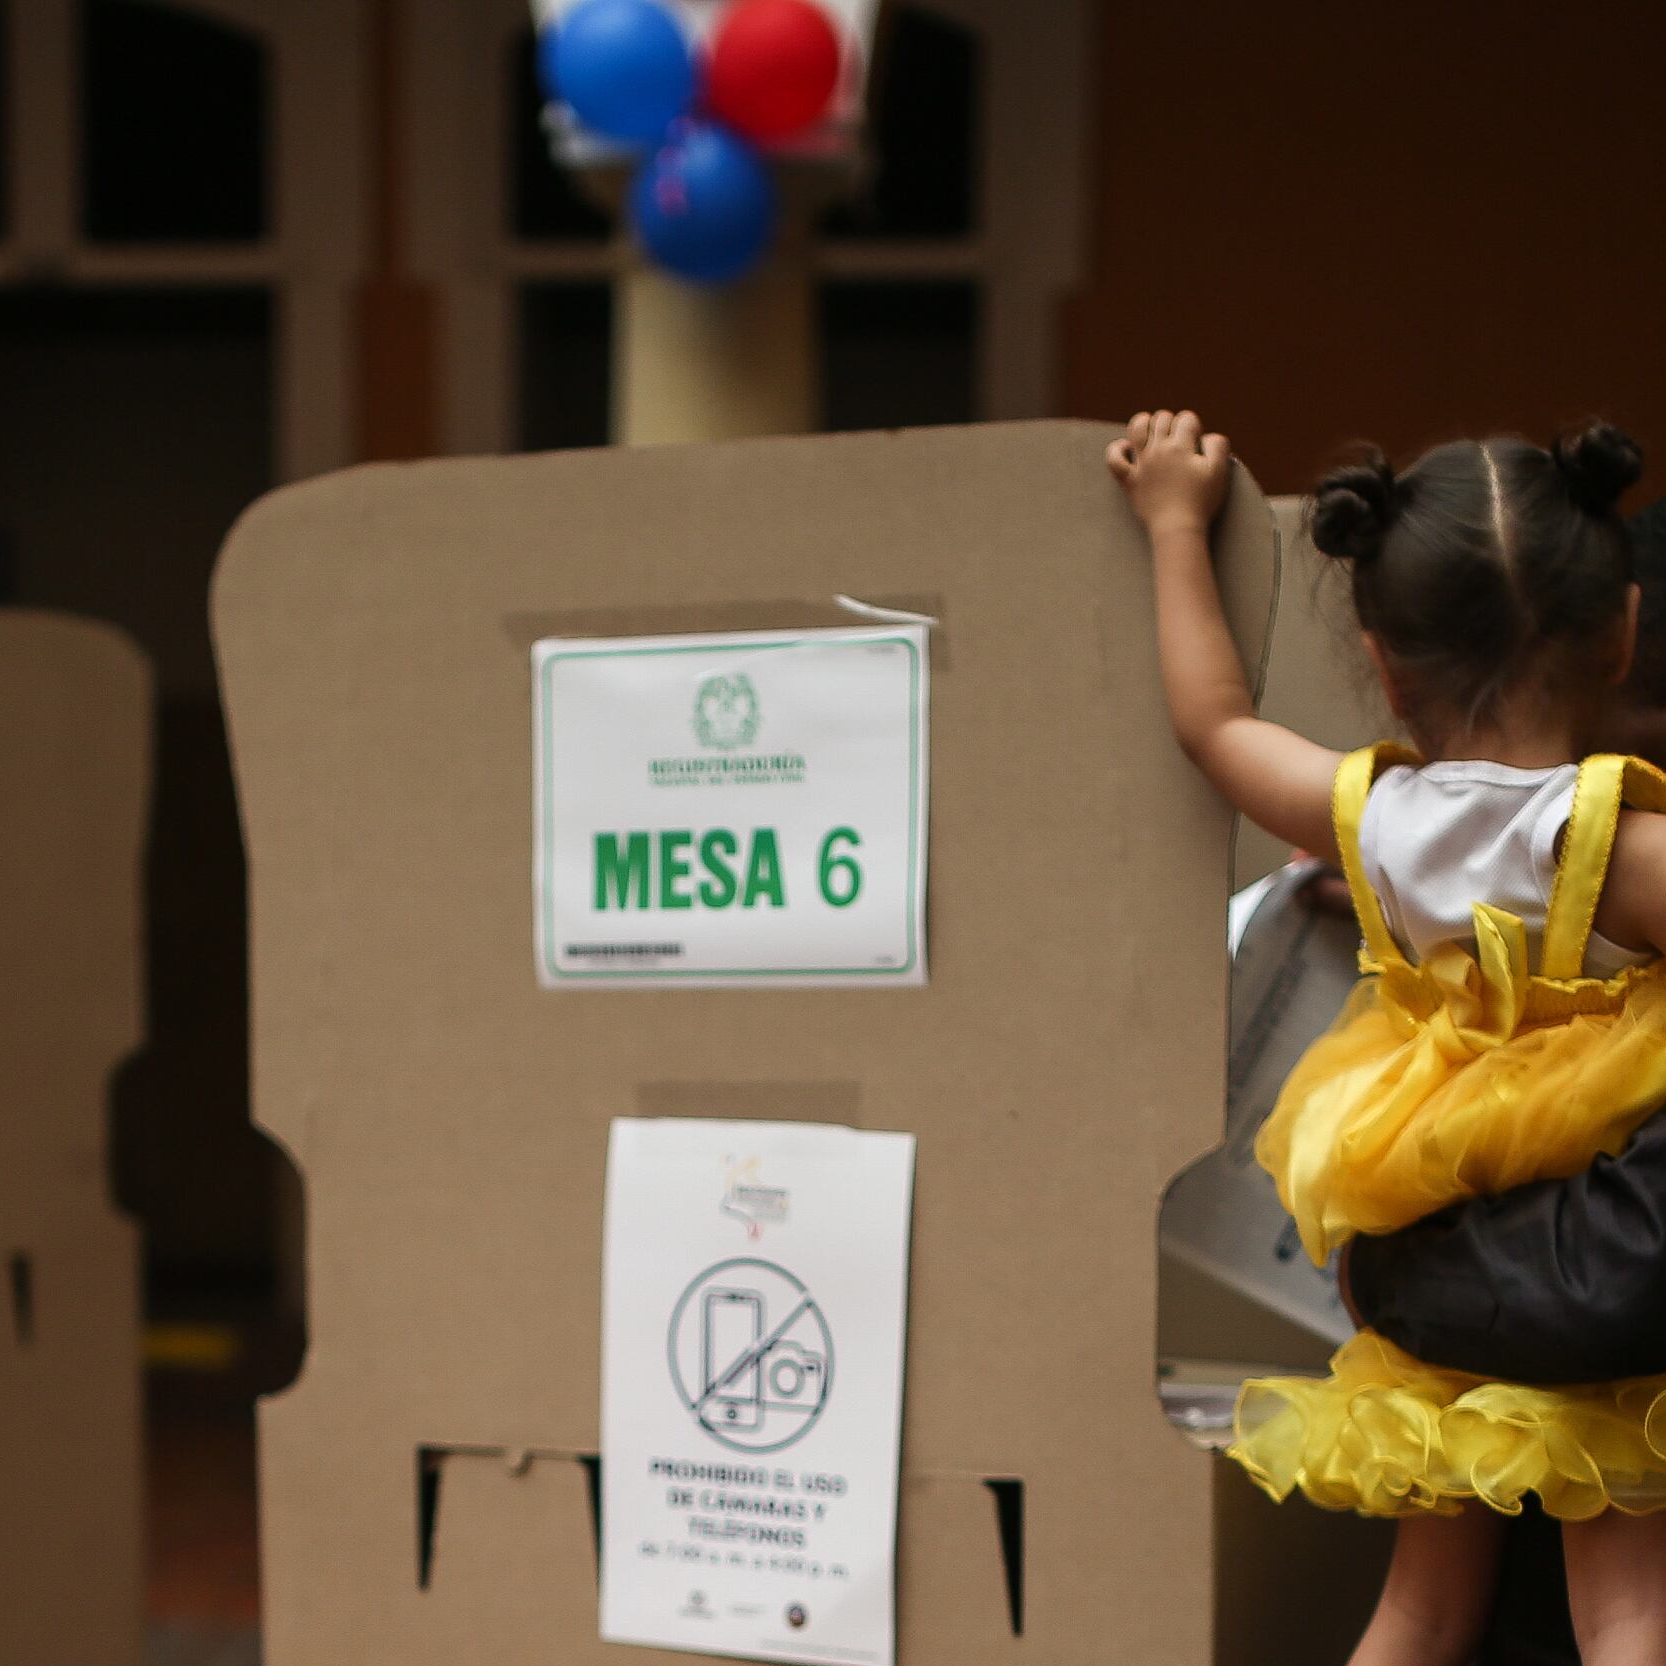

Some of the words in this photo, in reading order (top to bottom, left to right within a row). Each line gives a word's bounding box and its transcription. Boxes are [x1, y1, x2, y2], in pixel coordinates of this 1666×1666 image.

[593, 828, 786, 912] MESA
[818, 826, 863, 908] 6
[648, 1456, 769, 1489] PROHIBIDO
[773, 1467, 796, 1491] EL
[800, 1471, 848, 1496] USO
[666, 1485, 695, 1507] DE
[814, 1502, 827, 1522] Y
